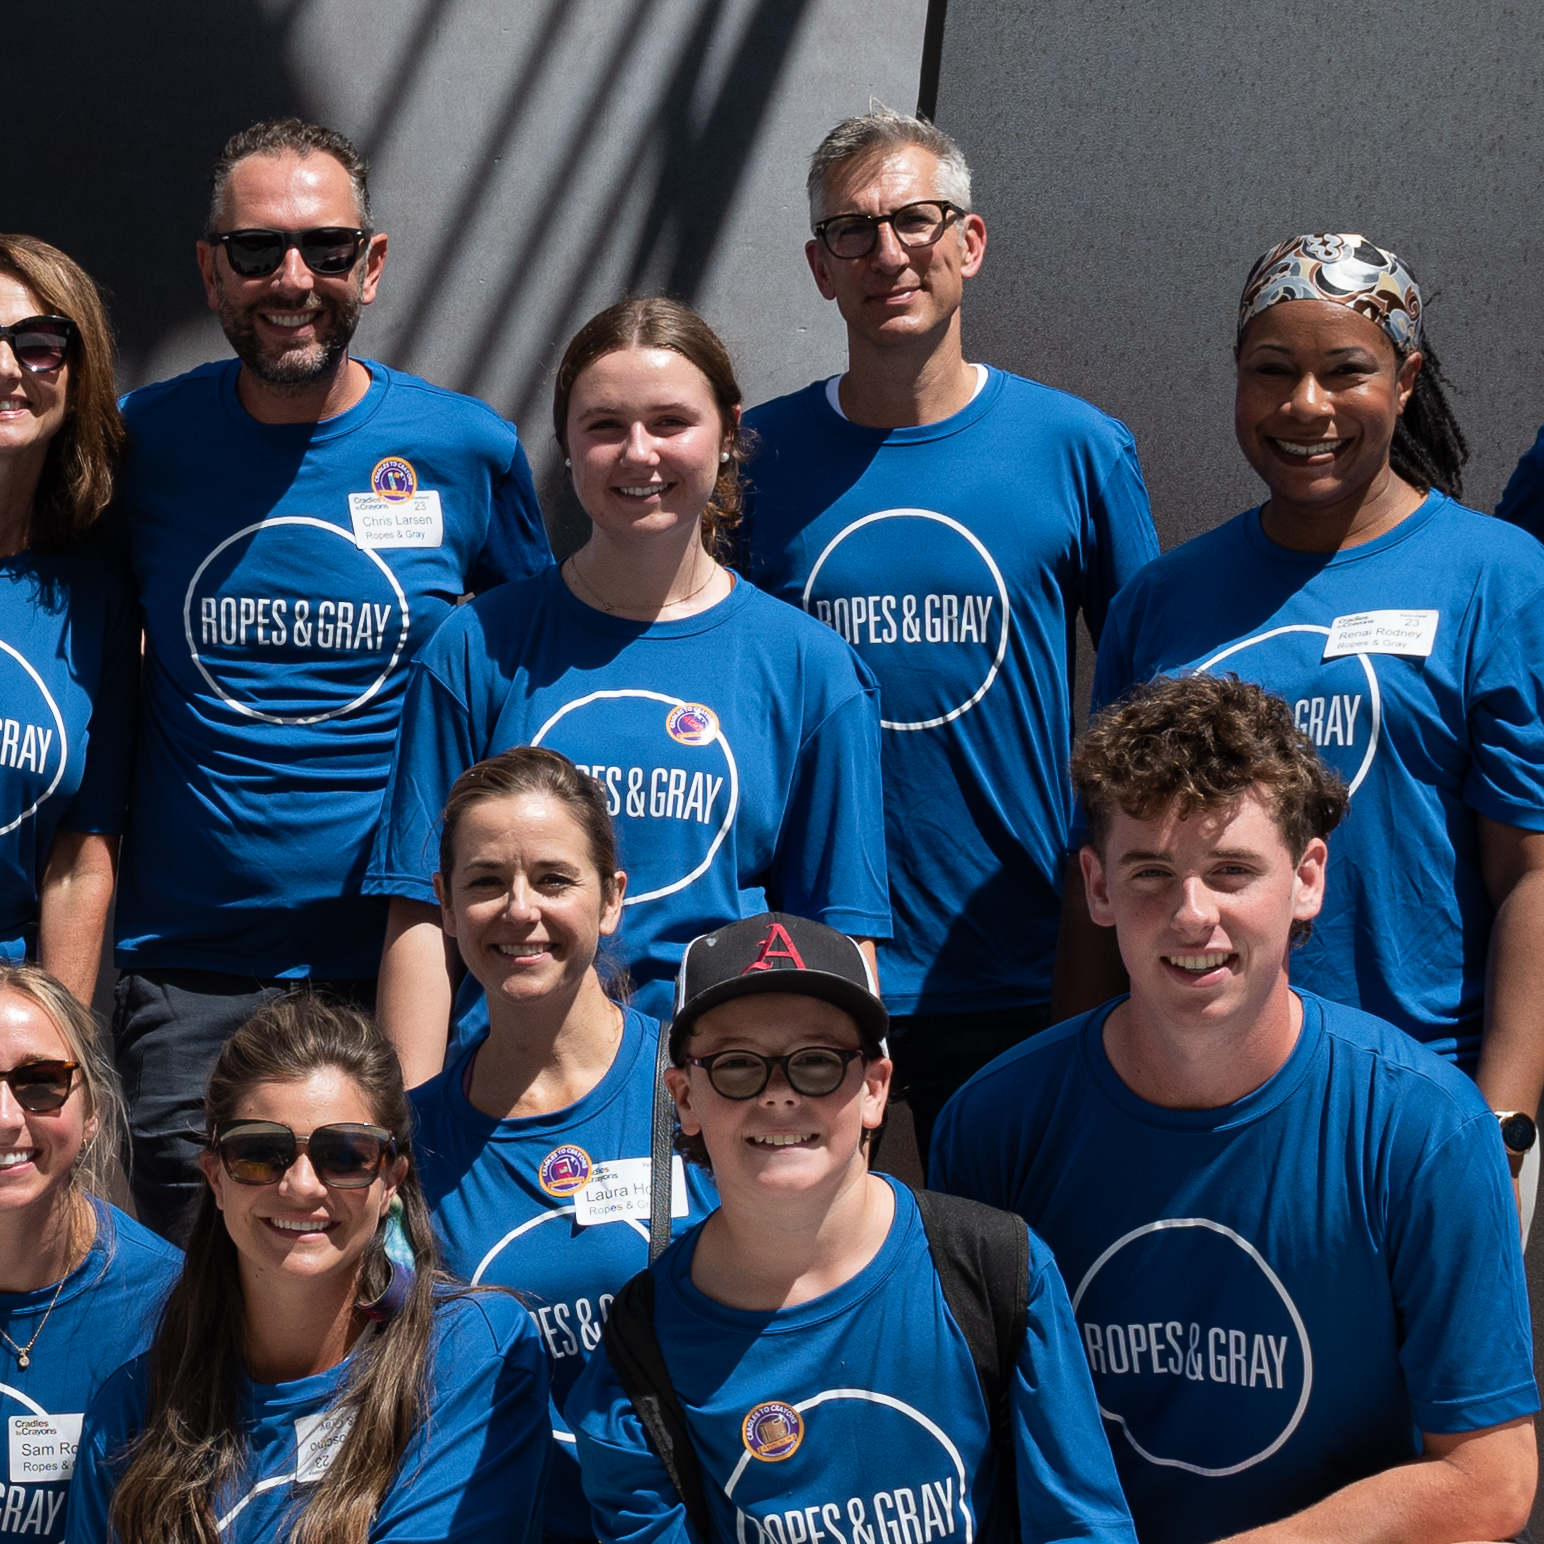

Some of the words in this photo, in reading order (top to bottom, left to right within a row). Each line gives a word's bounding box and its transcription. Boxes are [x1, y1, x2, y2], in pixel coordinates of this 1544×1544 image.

[362, 516, 392, 527] Chris
[395, 515, 433, 526] Larsen
[201, 597, 287, 646] ROPES
[294, 600, 312, 647] &
[318, 600, 391, 651] GRAY
[901, 595, 921, 643] &
[925, 595, 993, 644] GRAY
[1376, 628, 1423, 639] Rodney
[625, 769, 645, 817] &
[649, 767, 723, 825] GRAY
[741, 922, 806, 975] A
[586, 1186, 628, 1202] Laura
[633, 1183, 651, 1195] Ho
[575, 1297, 601, 1351] &
[1084, 1320, 1183, 1375] ROPES
[1187, 1322, 1203, 1381] &
[1208, 1327, 1288, 1389] GRAY
[22, 1443, 54, 1456] Sam
[60, 1442, 79, 1455] Ro
